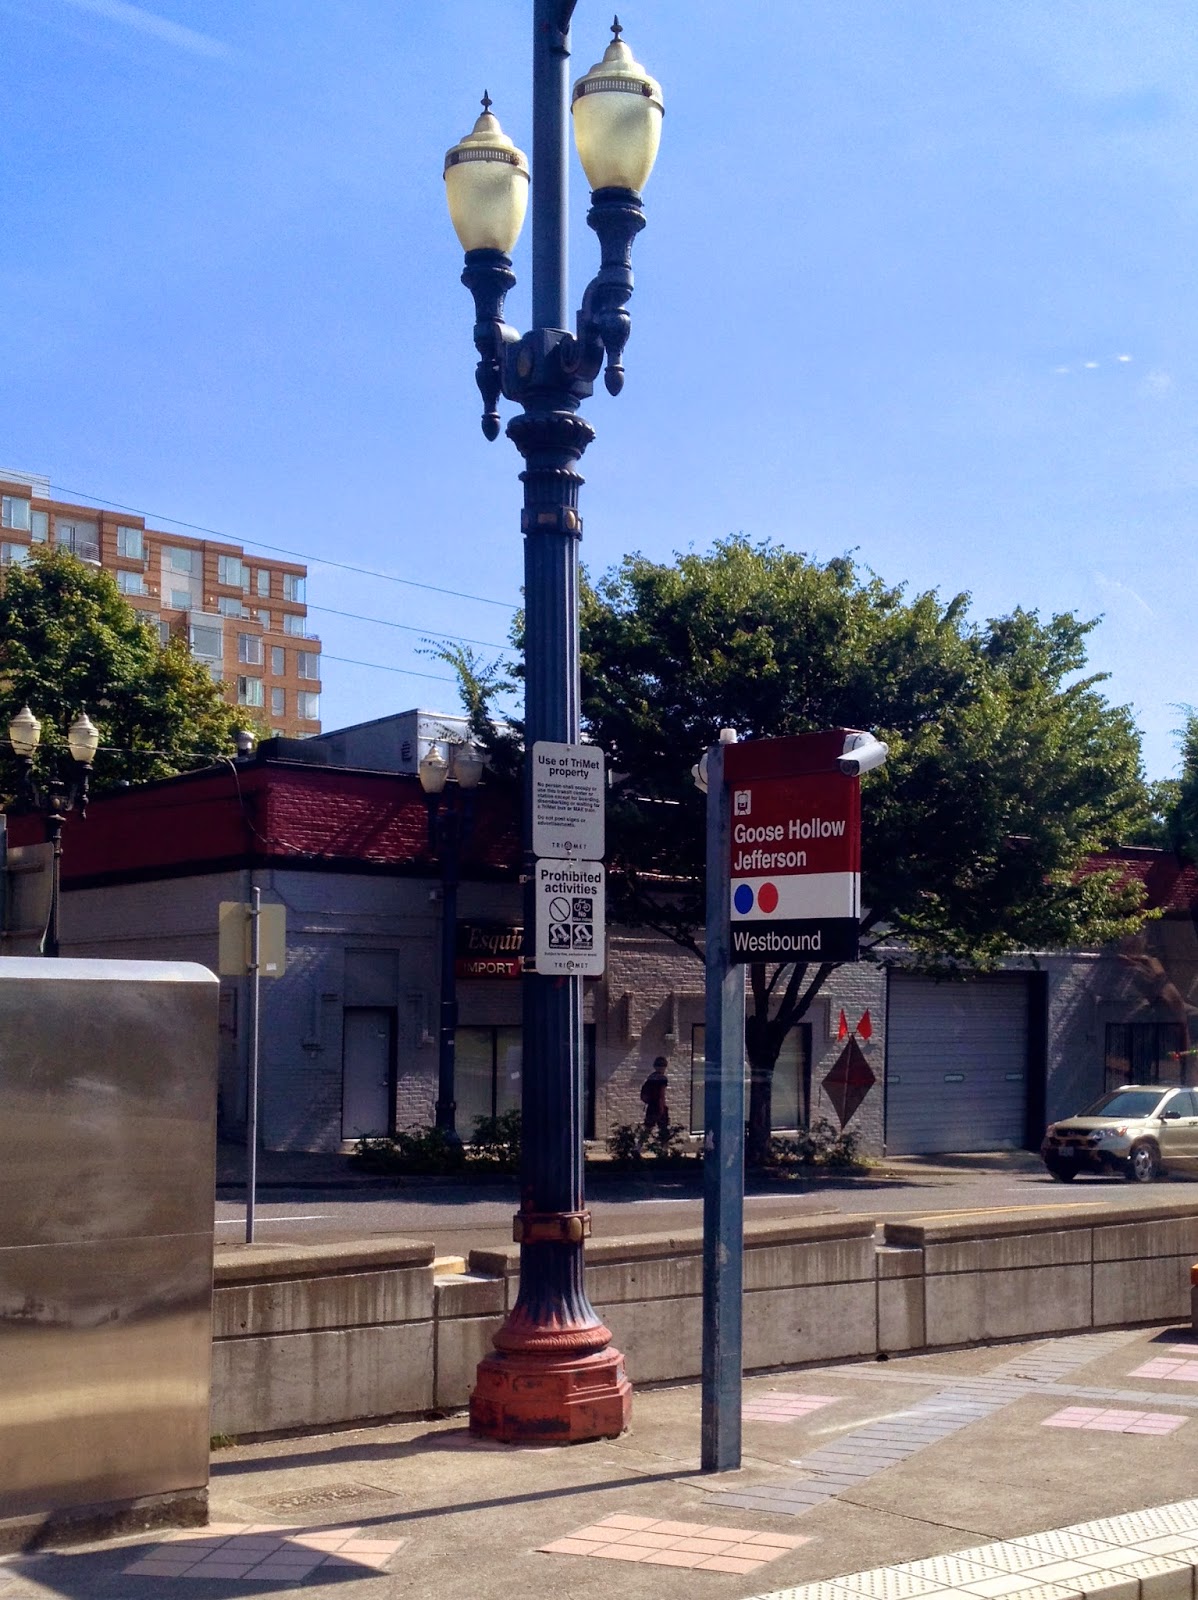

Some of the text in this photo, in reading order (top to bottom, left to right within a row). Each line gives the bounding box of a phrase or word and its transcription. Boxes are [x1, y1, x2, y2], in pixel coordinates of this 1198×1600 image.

[538, 756, 600, 770] Use of TriMet
[549, 767, 589, 780] property
[734, 818, 846, 843] Goose Hollow
[734, 850, 807, 870] Jefferson
[541, 870, 601, 883] Prohibited
[544, 882, 598, 895] activities
[734, 930, 821, 951] Westbound
[464, 962, 514, 974] IMPORT
